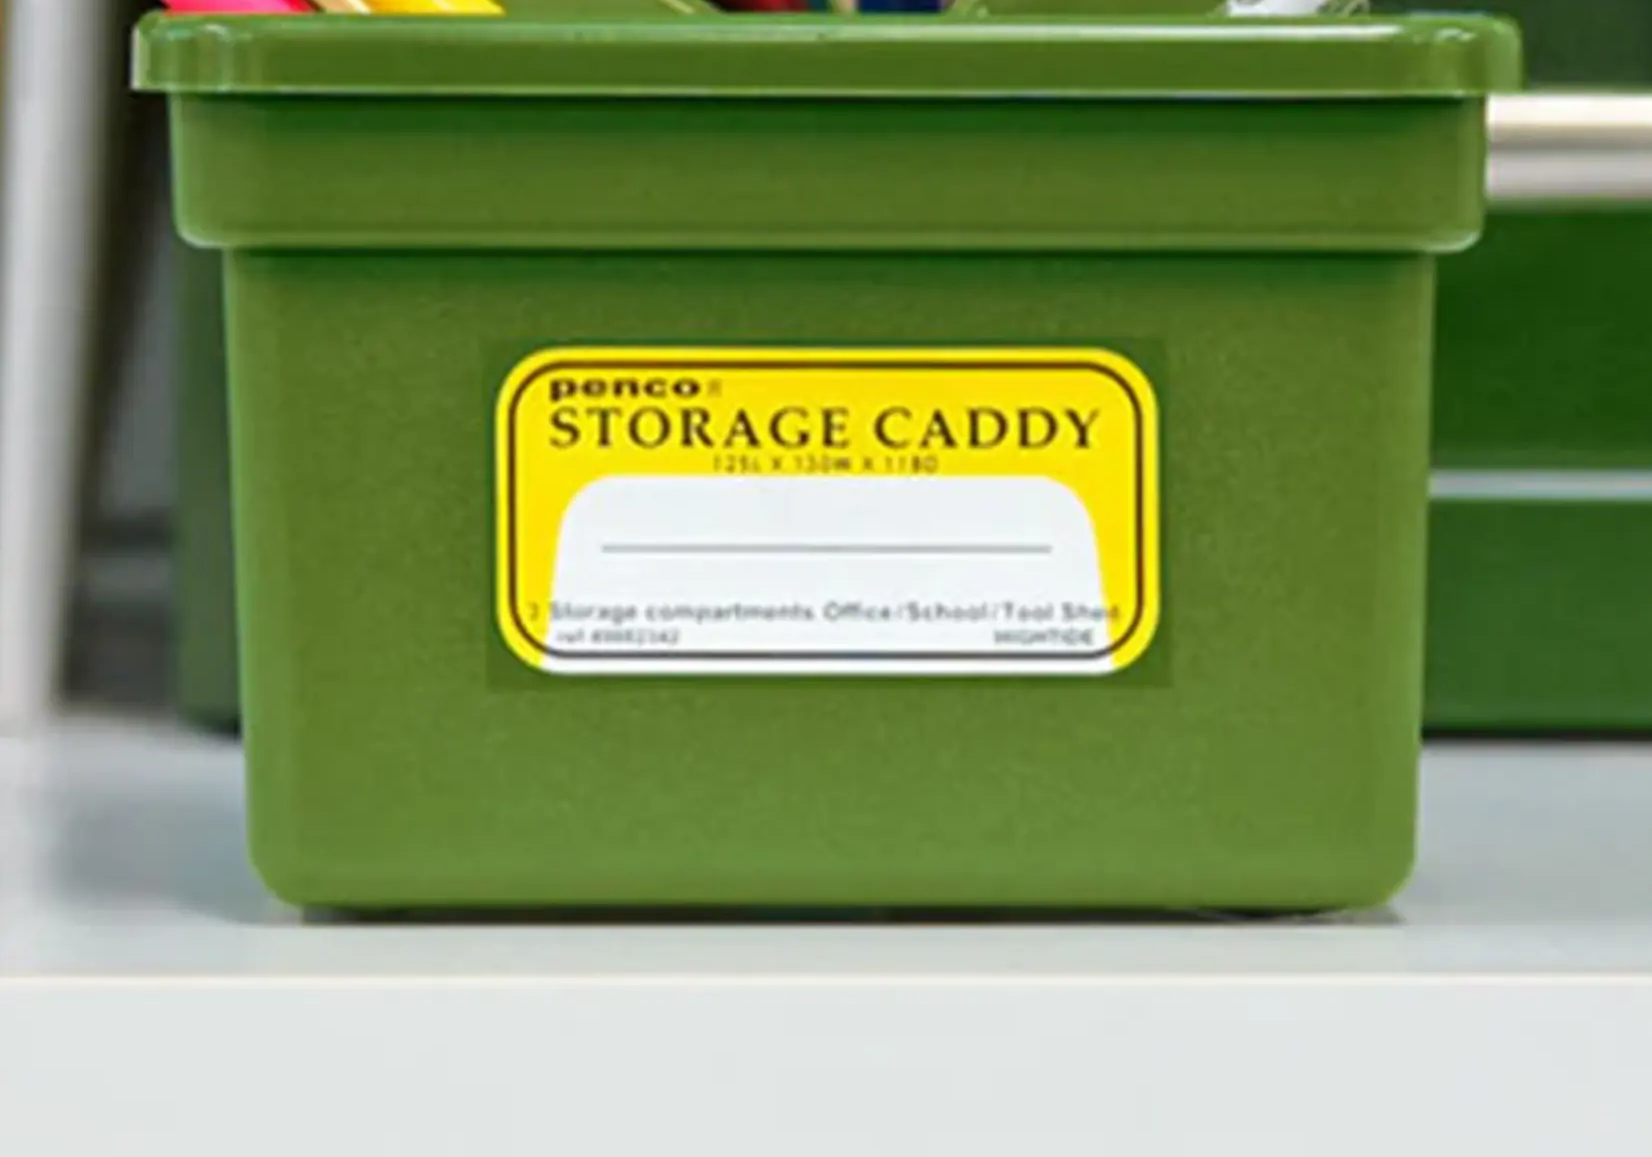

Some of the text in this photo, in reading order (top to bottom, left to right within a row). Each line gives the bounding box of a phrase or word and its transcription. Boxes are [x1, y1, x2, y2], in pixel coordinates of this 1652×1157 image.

[549, 377, 701, 402] penco
[548, 406, 1101, 449] STORAGE CADDY
[549, 601, 637, 622] Storage
